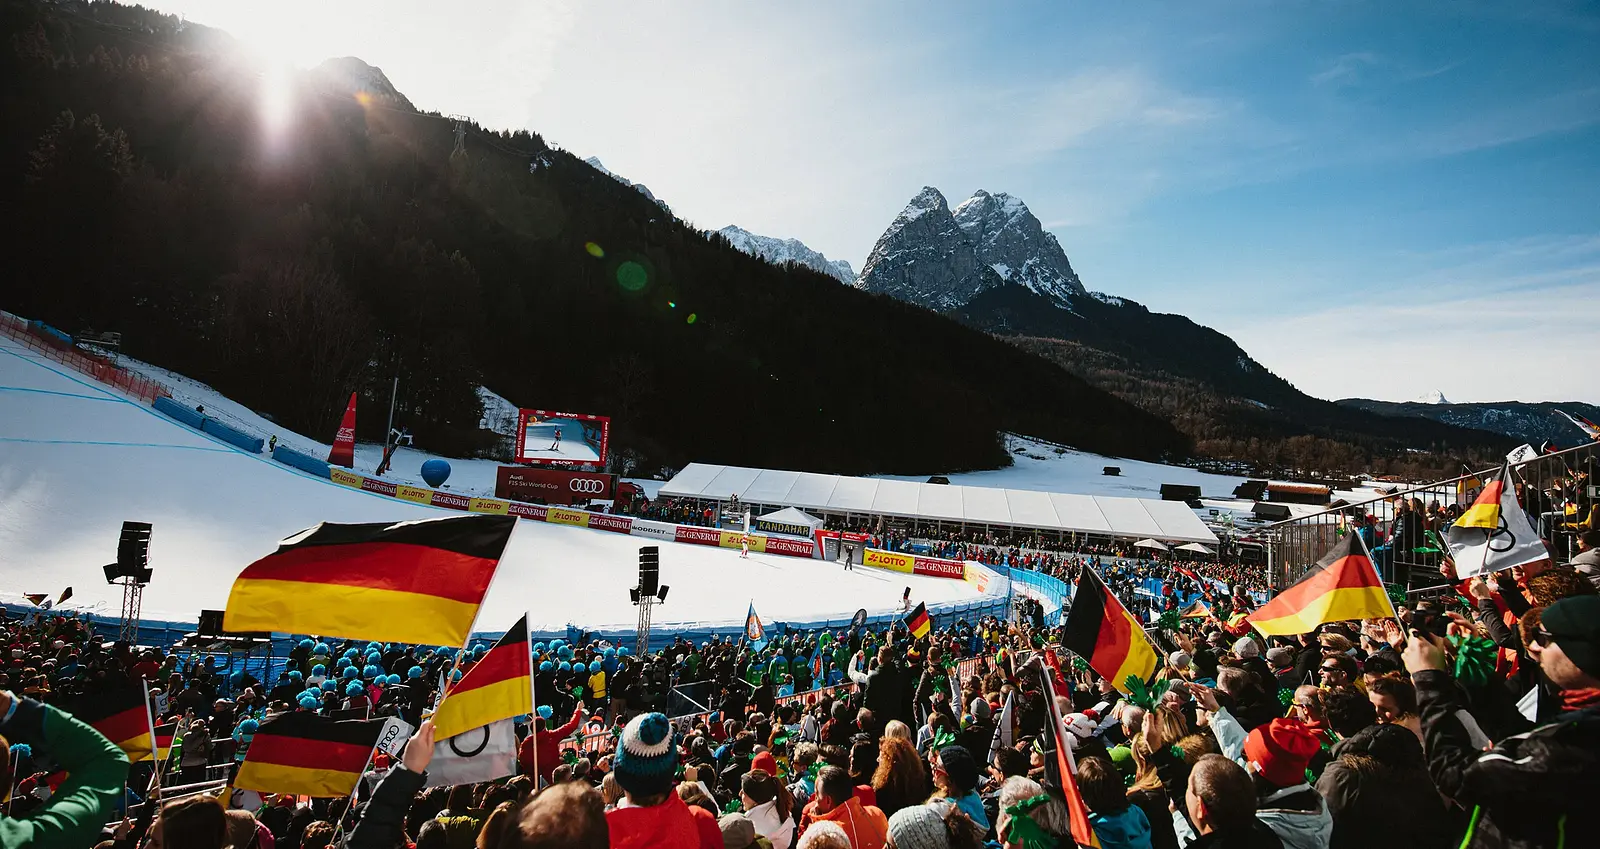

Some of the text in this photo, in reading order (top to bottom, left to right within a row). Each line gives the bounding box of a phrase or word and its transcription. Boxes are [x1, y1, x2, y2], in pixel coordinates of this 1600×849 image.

[370, 483, 396, 494] GENERALI
[440, 497, 469, 507] GENERALI
[517, 507, 547, 517] GENERALI
[598, 517, 631, 530] GENERALI
[759, 521, 808, 535] KANDAHAR
[686, 531, 720, 541] GENERALI
[777, 544, 813, 554] GENERALI
[879, 556, 906, 566] LOTTO
[926, 563, 963, 574] GENERAL
